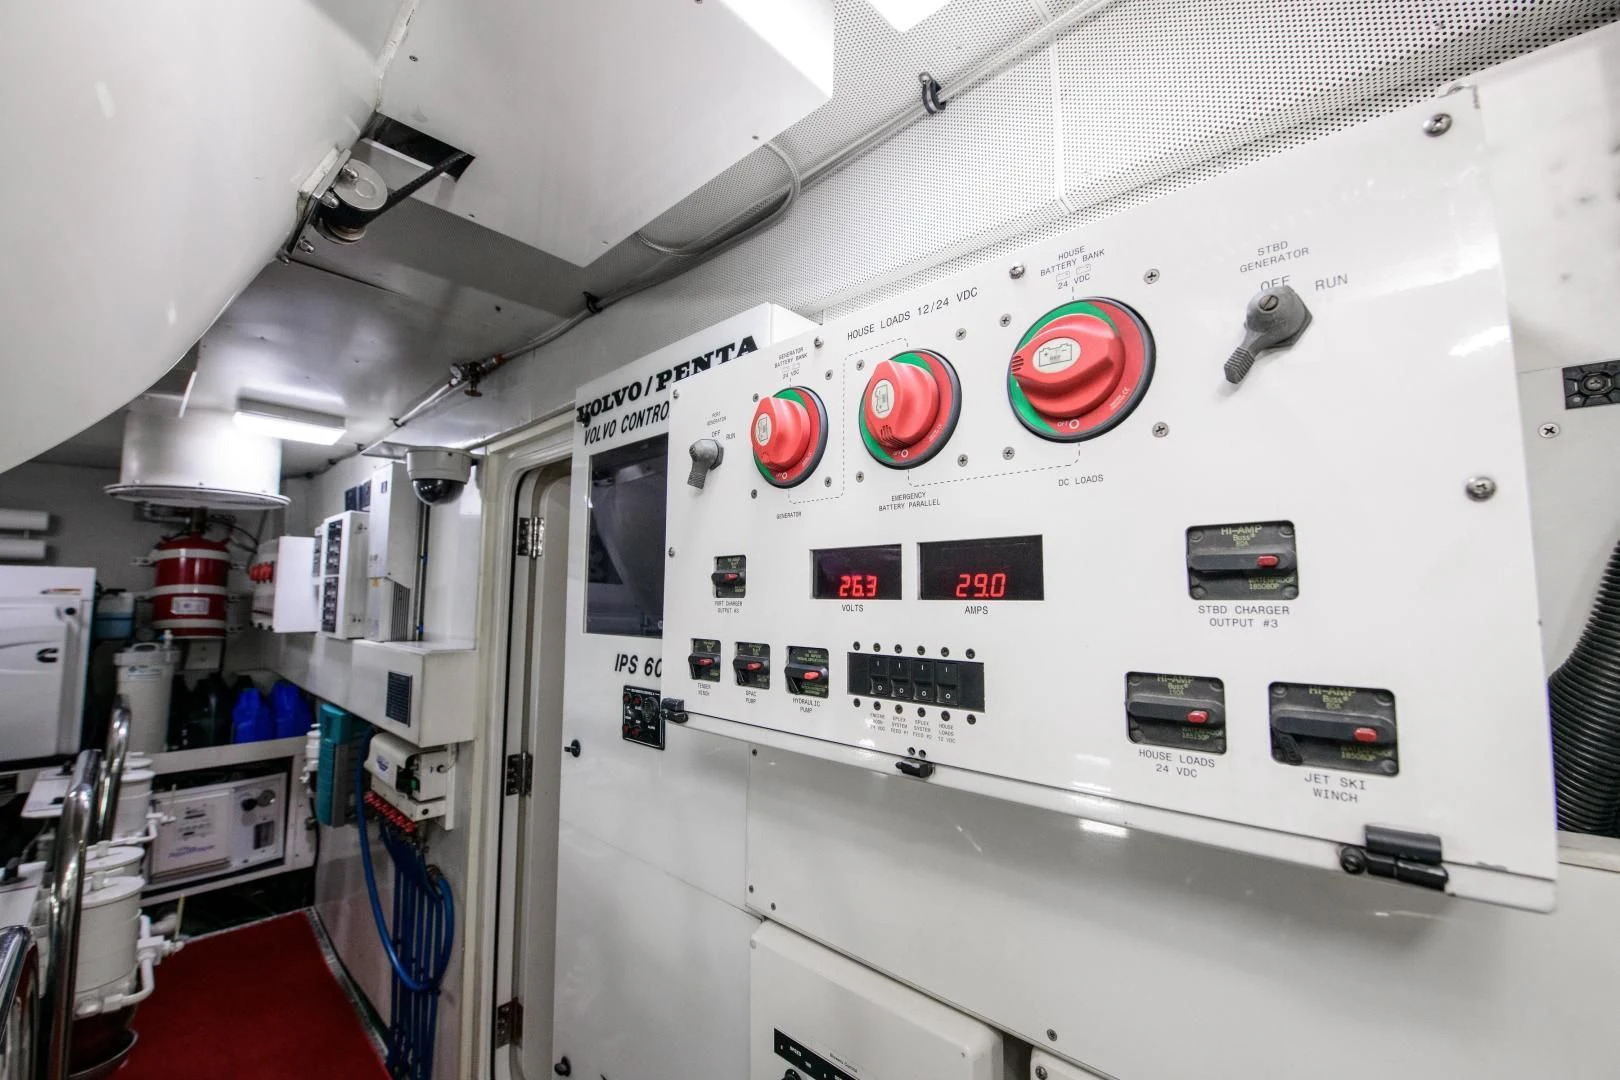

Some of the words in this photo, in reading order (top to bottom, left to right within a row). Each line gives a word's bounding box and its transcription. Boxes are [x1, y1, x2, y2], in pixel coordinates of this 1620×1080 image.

[1058, 246, 1085, 260] HOUSE
[1257, 240, 1288, 256] STBD
[1040, 259, 1077, 276] BATTERY
[1082, 248, 1104, 262] BANK
[1239, 247, 1309, 272] GENERATOR
[1057, 281, 1068, 289] 24
[1073, 273, 1090, 284] VDC
[1260, 275, 1290, 292] OFF
[1314, 273, 1348, 291] RUN
[846, 323, 875, 340] HOUSE
[880, 311, 910, 330] LOADS
[917, 296, 950, 316] 12/24
[956, 286, 978, 302] VDC
[774, 358, 794, 368] BATTERY
[795, 352, 808, 363] BANK
[778, 347, 804, 360] GENERATOR
[790, 369, 800, 378] VDC
[584, 414, 617, 446] VOLVO
[621, 400, 669, 433] CONTRO
[711, 429, 721, 438] OFF
[725, 432, 736, 440] RUN
[1058, 478, 1070, 487] DC
[1075, 474, 1104, 485] LOADS
[891, 491, 926, 501] EMERGENCY
[878, 503, 905, 511] BATTERY
[908, 499, 940, 508] PARALLEL
[776, 511, 802, 520] GENERATOR
[1221, 525, 1262, 535] HI-AMP
[839, 575, 878, 597] 26.3
[955, 573, 1006, 597] 29.0
[841, 604, 864, 613] VOLTS
[964, 606, 989, 615] AMPS
[1198, 605, 1228, 614] STBD
[1234, 605, 1290, 615] CHARGER
[1209, 618, 1254, 628] OUTPUT
[1263, 619, 1278, 628] #3
[614, 653, 639, 674] IPS
[792, 698, 820, 707] HYDRAULIC
[1139, 748, 1172, 761] HOUSE
[1179, 755, 1215, 768] LOADS
[1156, 763, 1169, 772] 24
[1176, 767, 1198, 778] VDC
[1304, 773, 1330, 785] JET
[1340, 777, 1366, 790] SKI
[1313, 788, 1358, 803] WINCH
